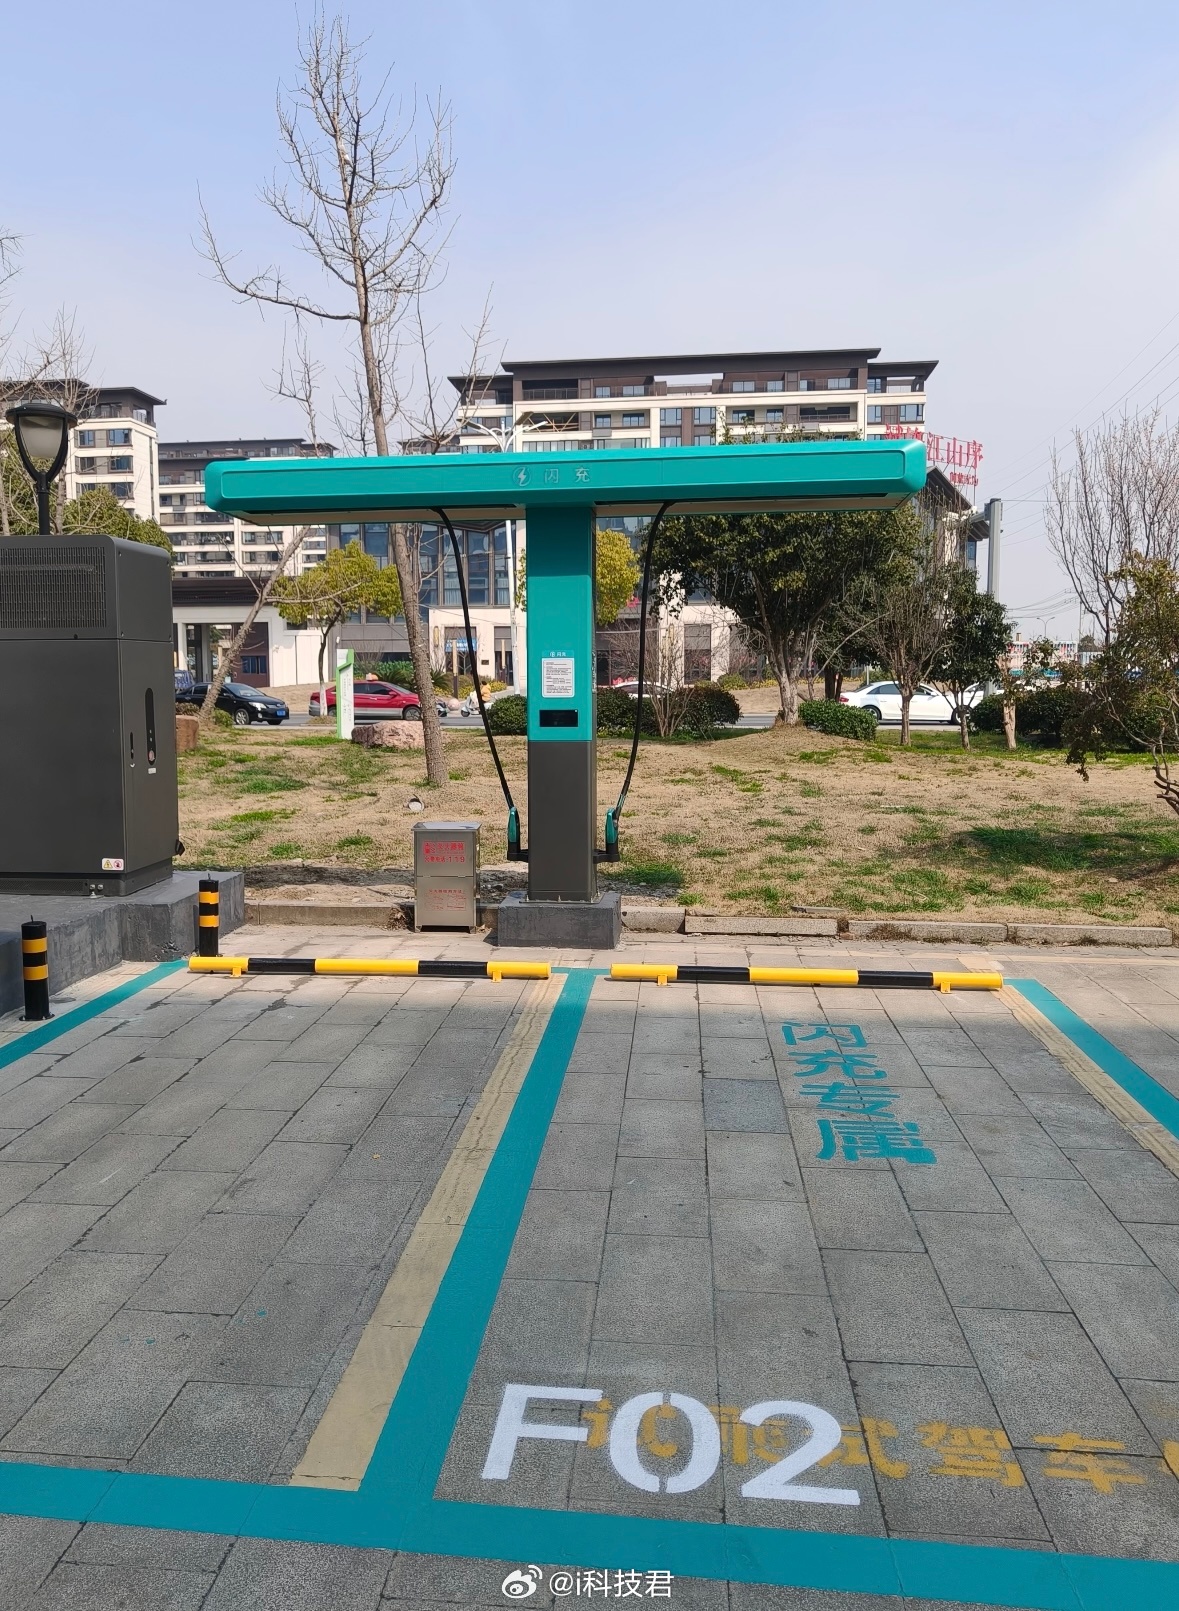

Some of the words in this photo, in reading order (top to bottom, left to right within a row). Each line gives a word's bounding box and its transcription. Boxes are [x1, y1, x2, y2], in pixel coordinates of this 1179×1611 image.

[544, 467, 590, 484] 闪充
[781, 1021, 938, 1165] 闪充专属
[481, 1383, 860, 1506] F02
